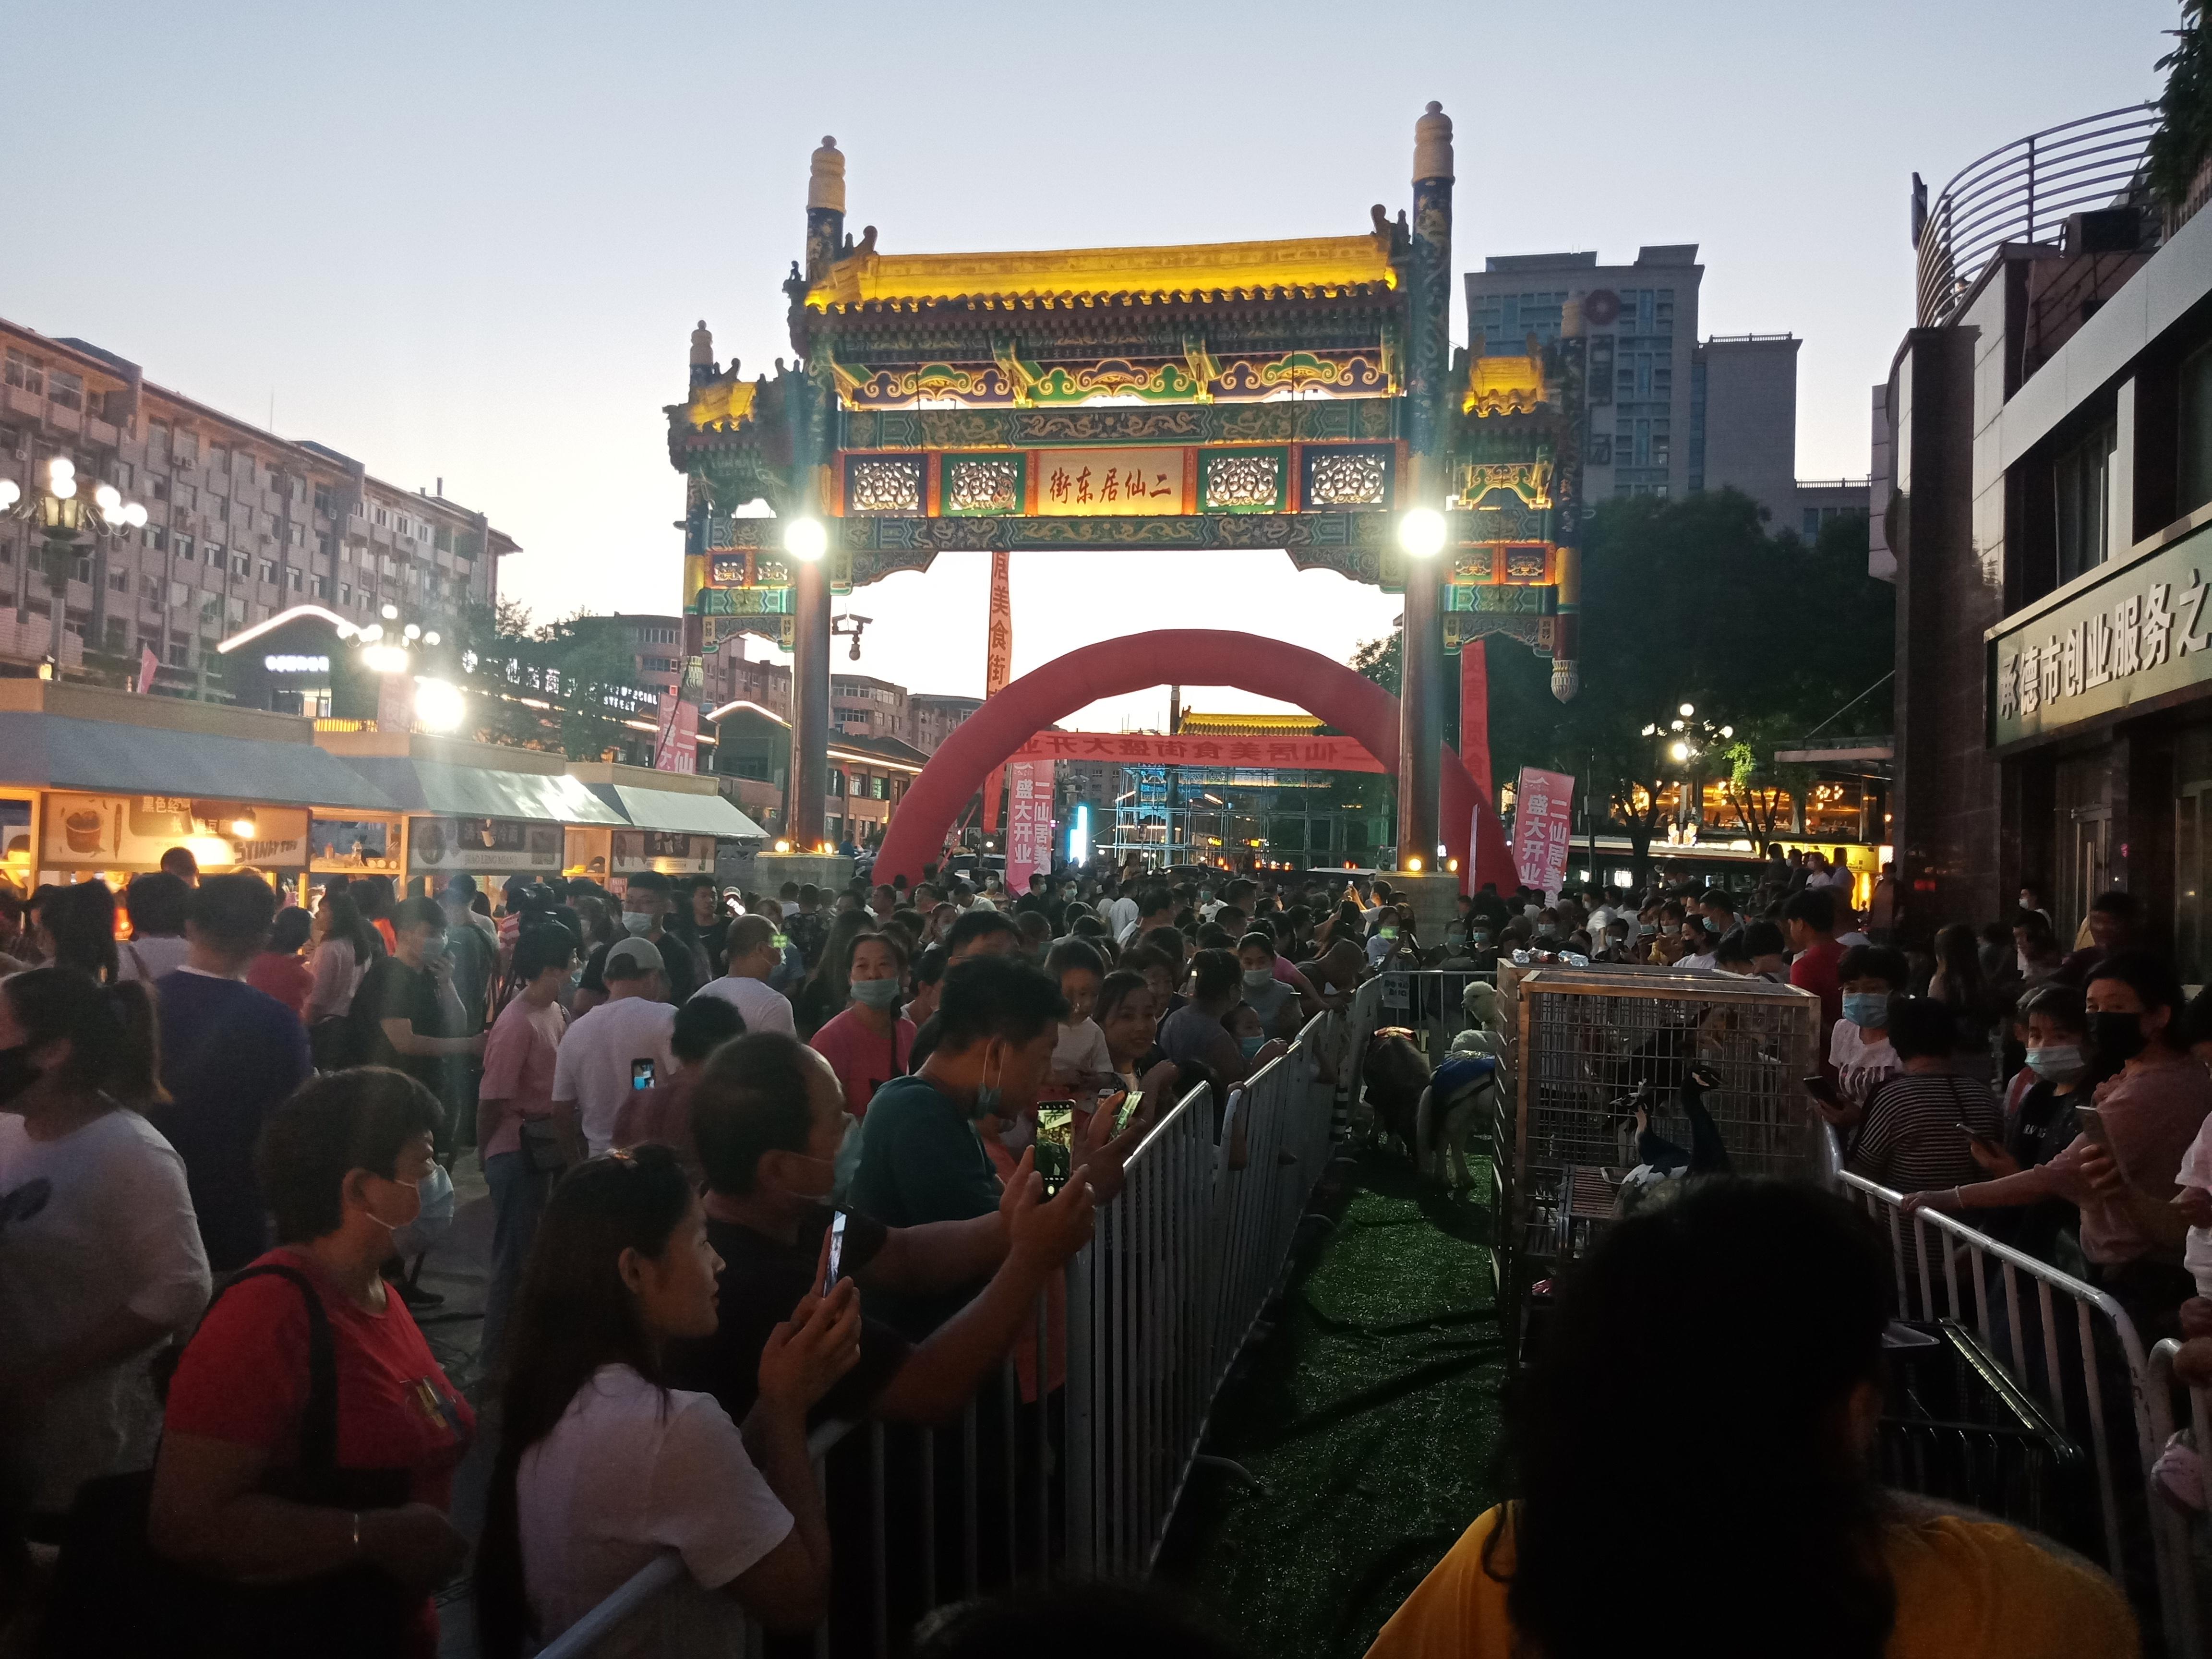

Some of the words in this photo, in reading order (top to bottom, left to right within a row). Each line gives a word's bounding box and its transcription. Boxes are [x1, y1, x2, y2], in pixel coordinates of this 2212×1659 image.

[2000, 568, 2212, 720] 承德市创业服务之
[171, 816, 232, 835] 长臭豆
[1013, 779, 1033, 864] 盛大开业
[1520, 793, 1549, 886] 盛大开业
